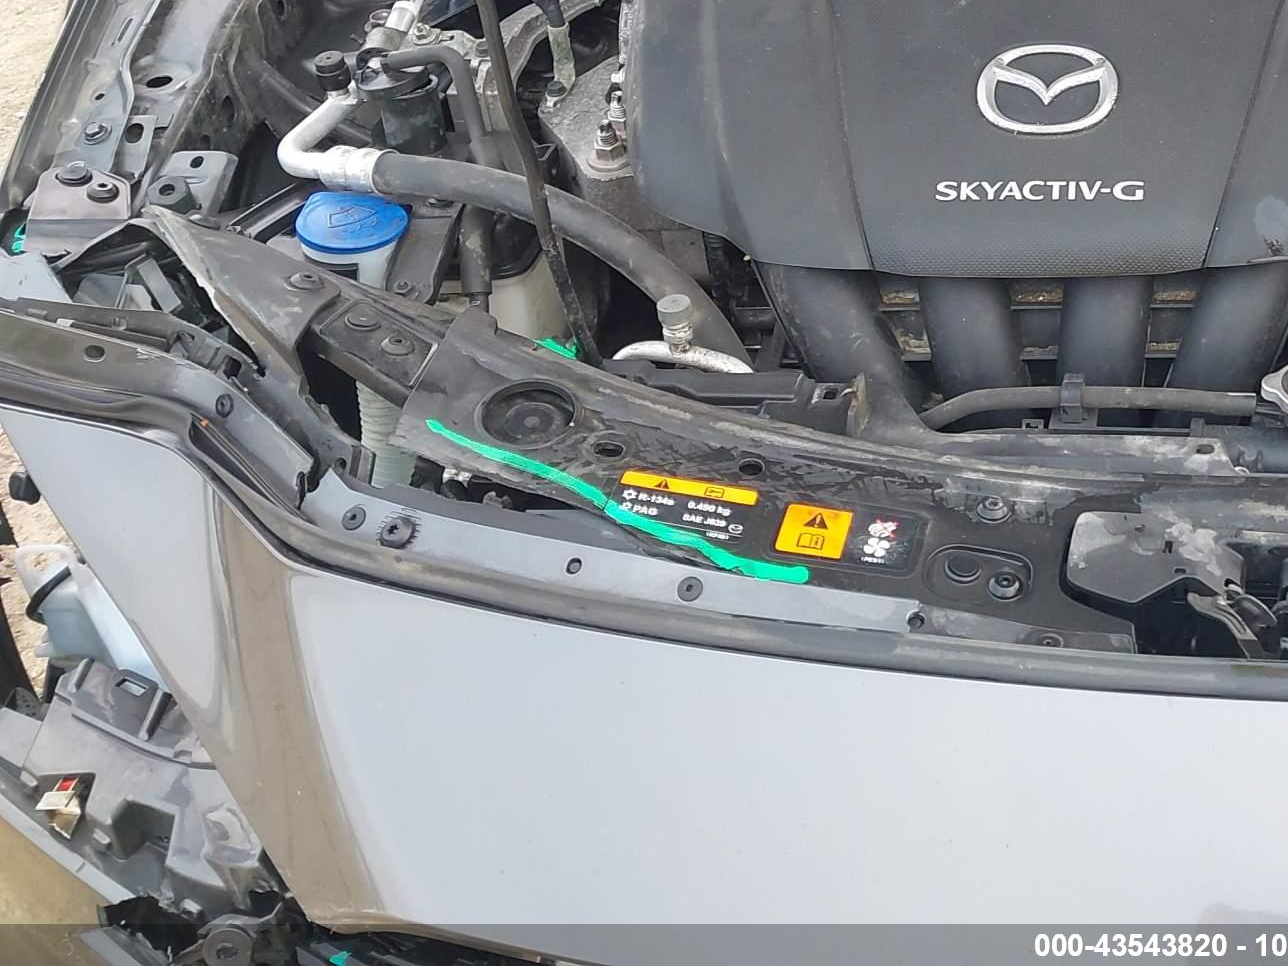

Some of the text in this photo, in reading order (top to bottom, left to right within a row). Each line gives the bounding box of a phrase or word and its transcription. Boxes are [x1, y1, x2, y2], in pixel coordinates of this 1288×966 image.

[935, 180, 1145, 202] SKYACTIV-G
[632, 504, 659, 516] PAG
[682, 513, 704, 524] SAE
[638, 492, 675, 506] R-134a
[716, 505, 732, 517] kg
